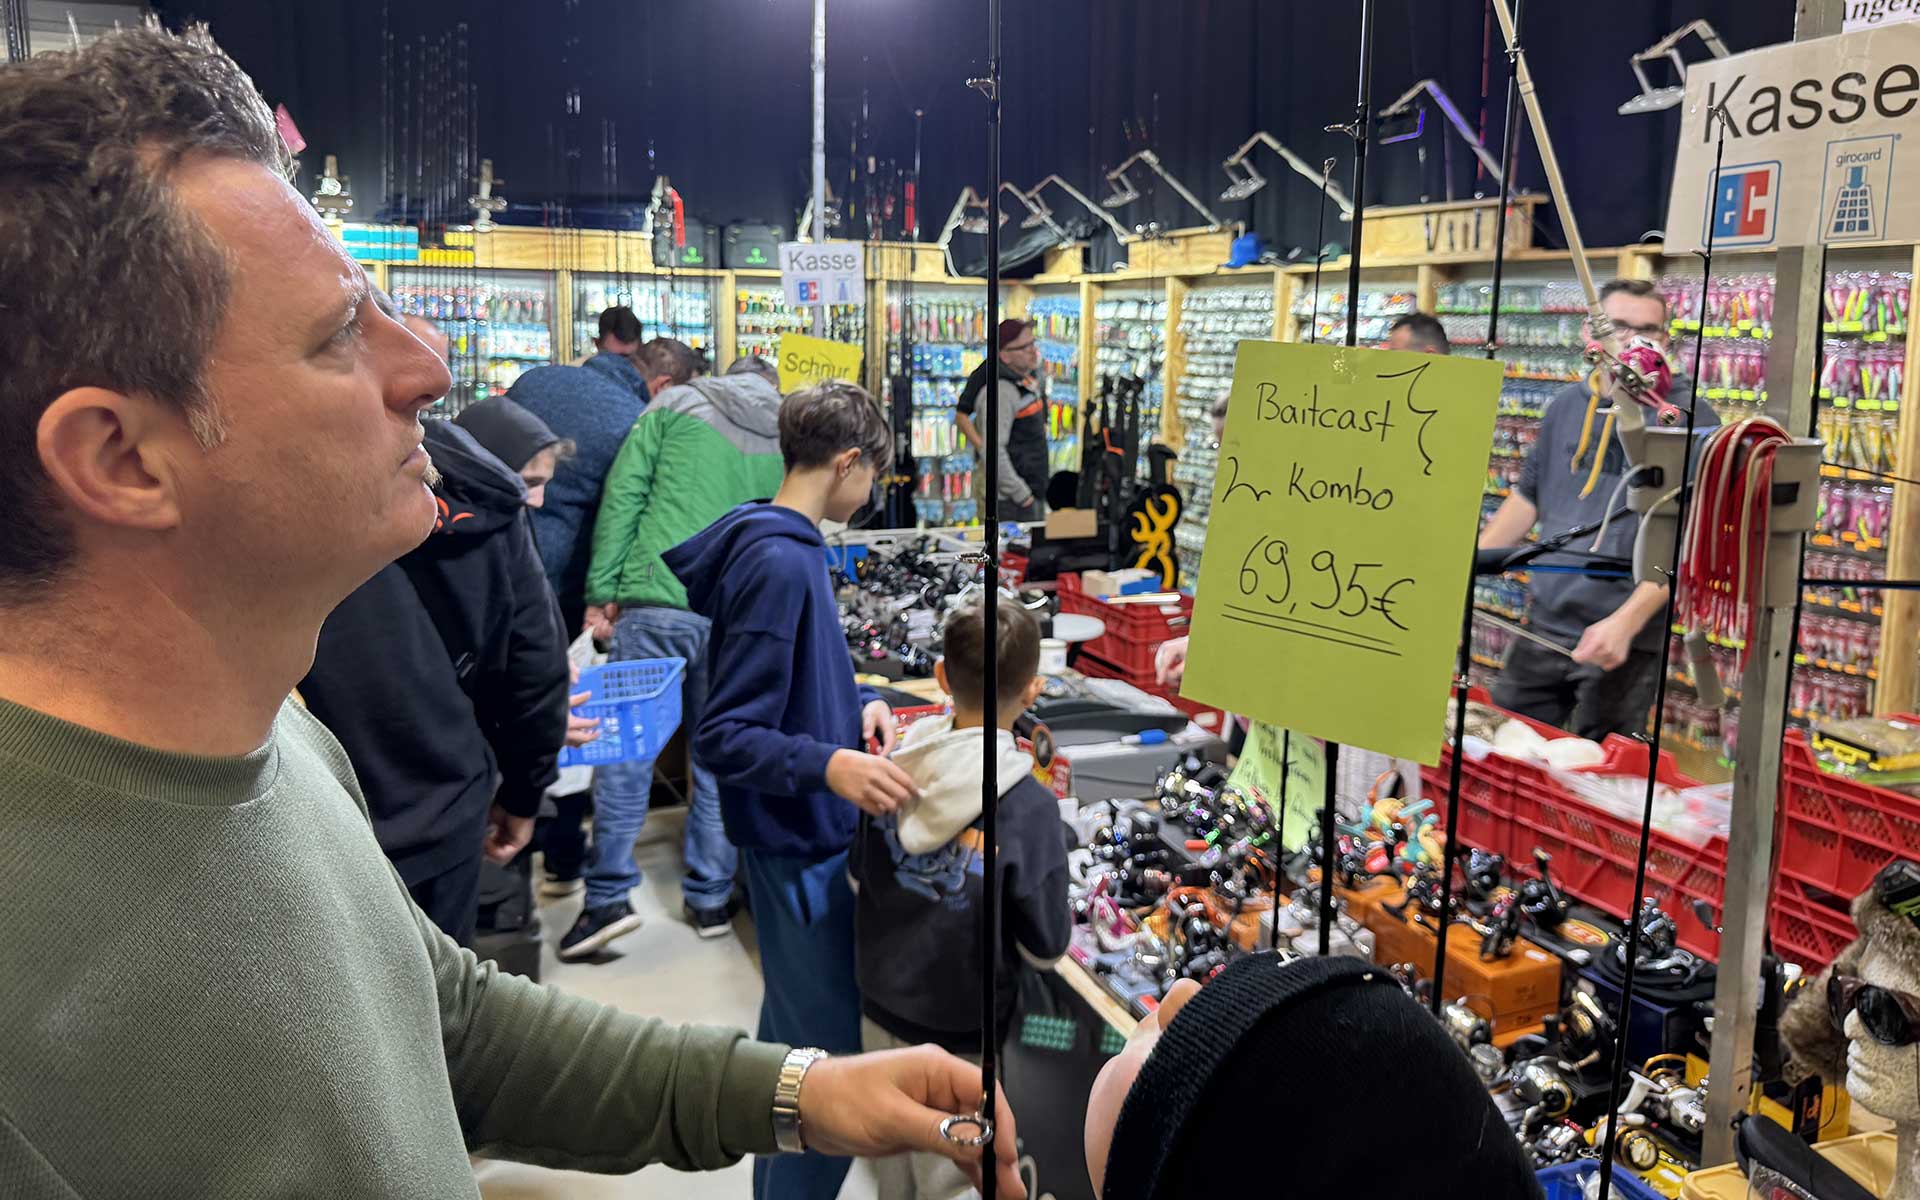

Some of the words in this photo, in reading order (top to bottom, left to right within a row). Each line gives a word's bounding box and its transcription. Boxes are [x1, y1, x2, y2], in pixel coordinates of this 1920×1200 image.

[1704, 64, 1920, 144] Kasse
[1836, 147, 1882, 168] girocard
[788, 250, 857, 272] Kasse
[784, 352, 850, 378] Schnur
[1256, 382, 1396, 442] Baitcast
[1289, 462, 1394, 511] Kombo
[1239, 535, 1416, 631] 69,95€
